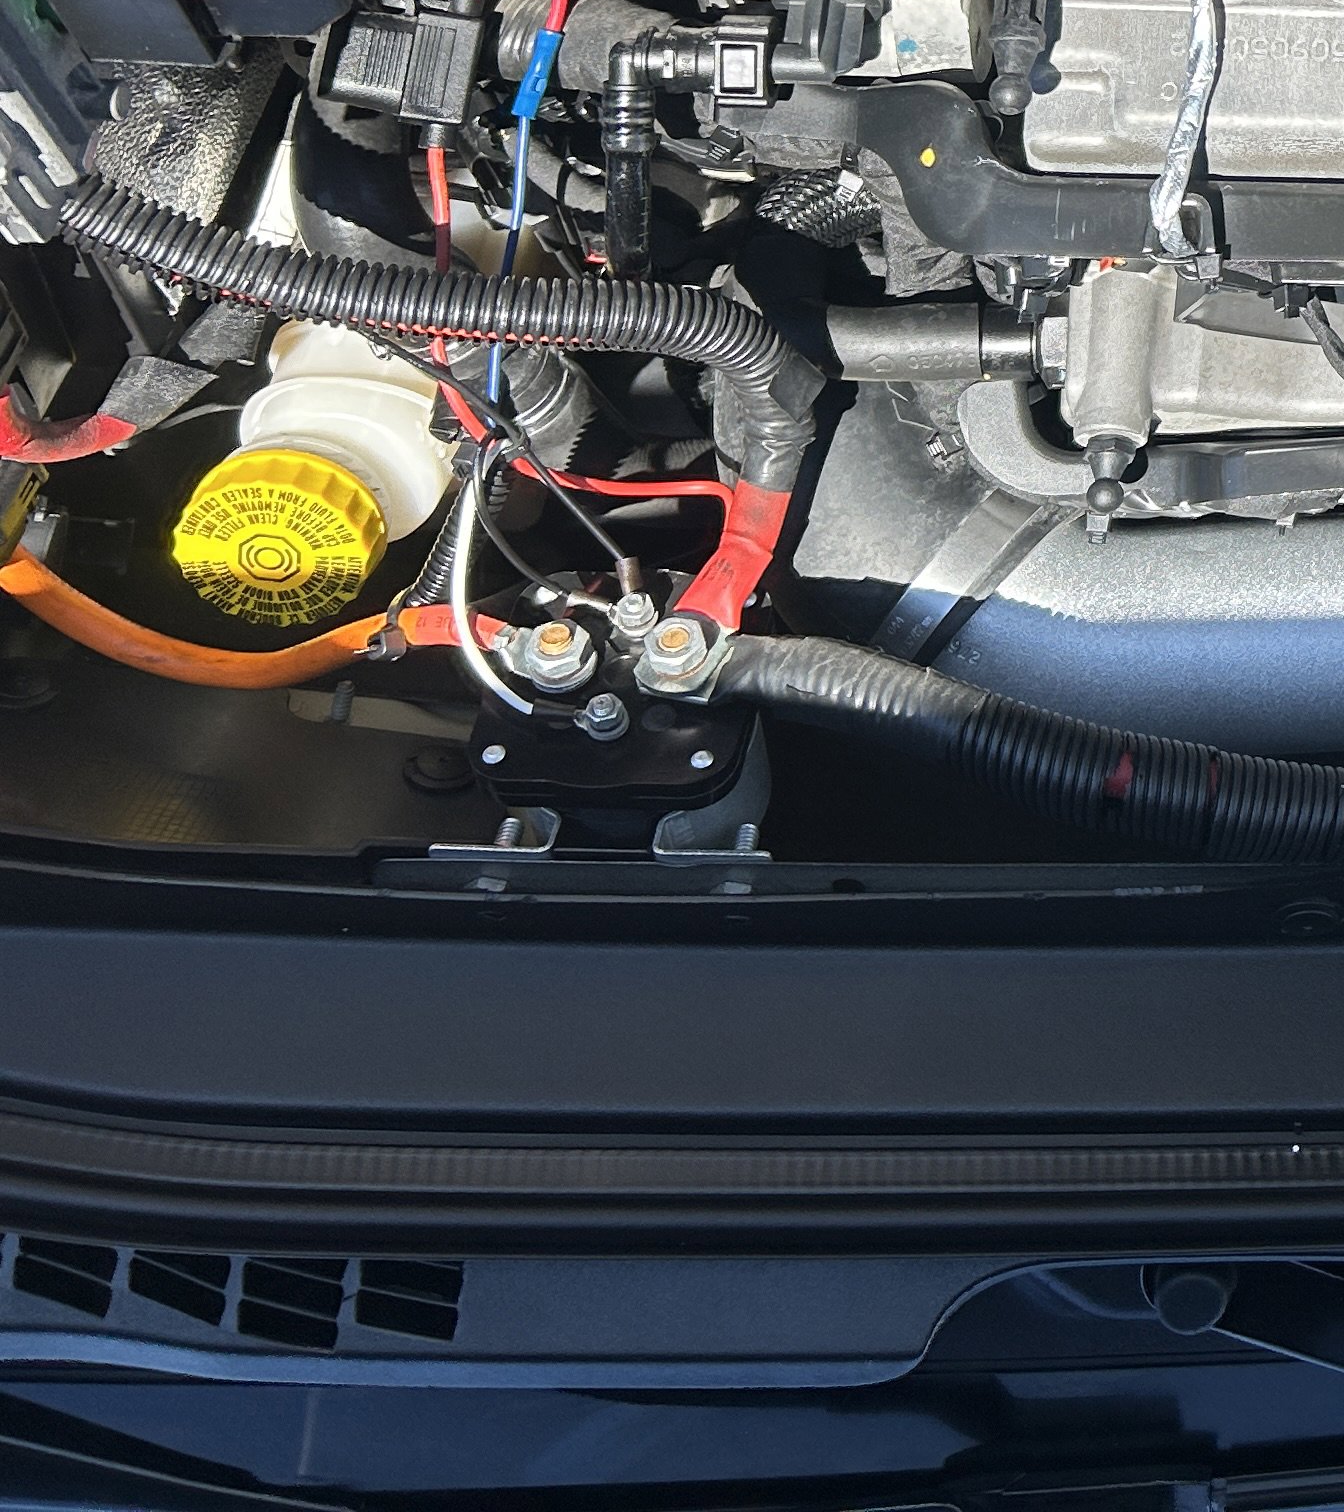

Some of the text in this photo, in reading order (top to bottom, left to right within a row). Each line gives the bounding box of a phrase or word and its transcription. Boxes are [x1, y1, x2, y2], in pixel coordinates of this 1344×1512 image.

[221, 488, 262, 503] SEALED
[278, 490, 308, 508] FROM
[247, 513, 279, 525] CLEAN
[291, 507, 324, 534] BEFORE
